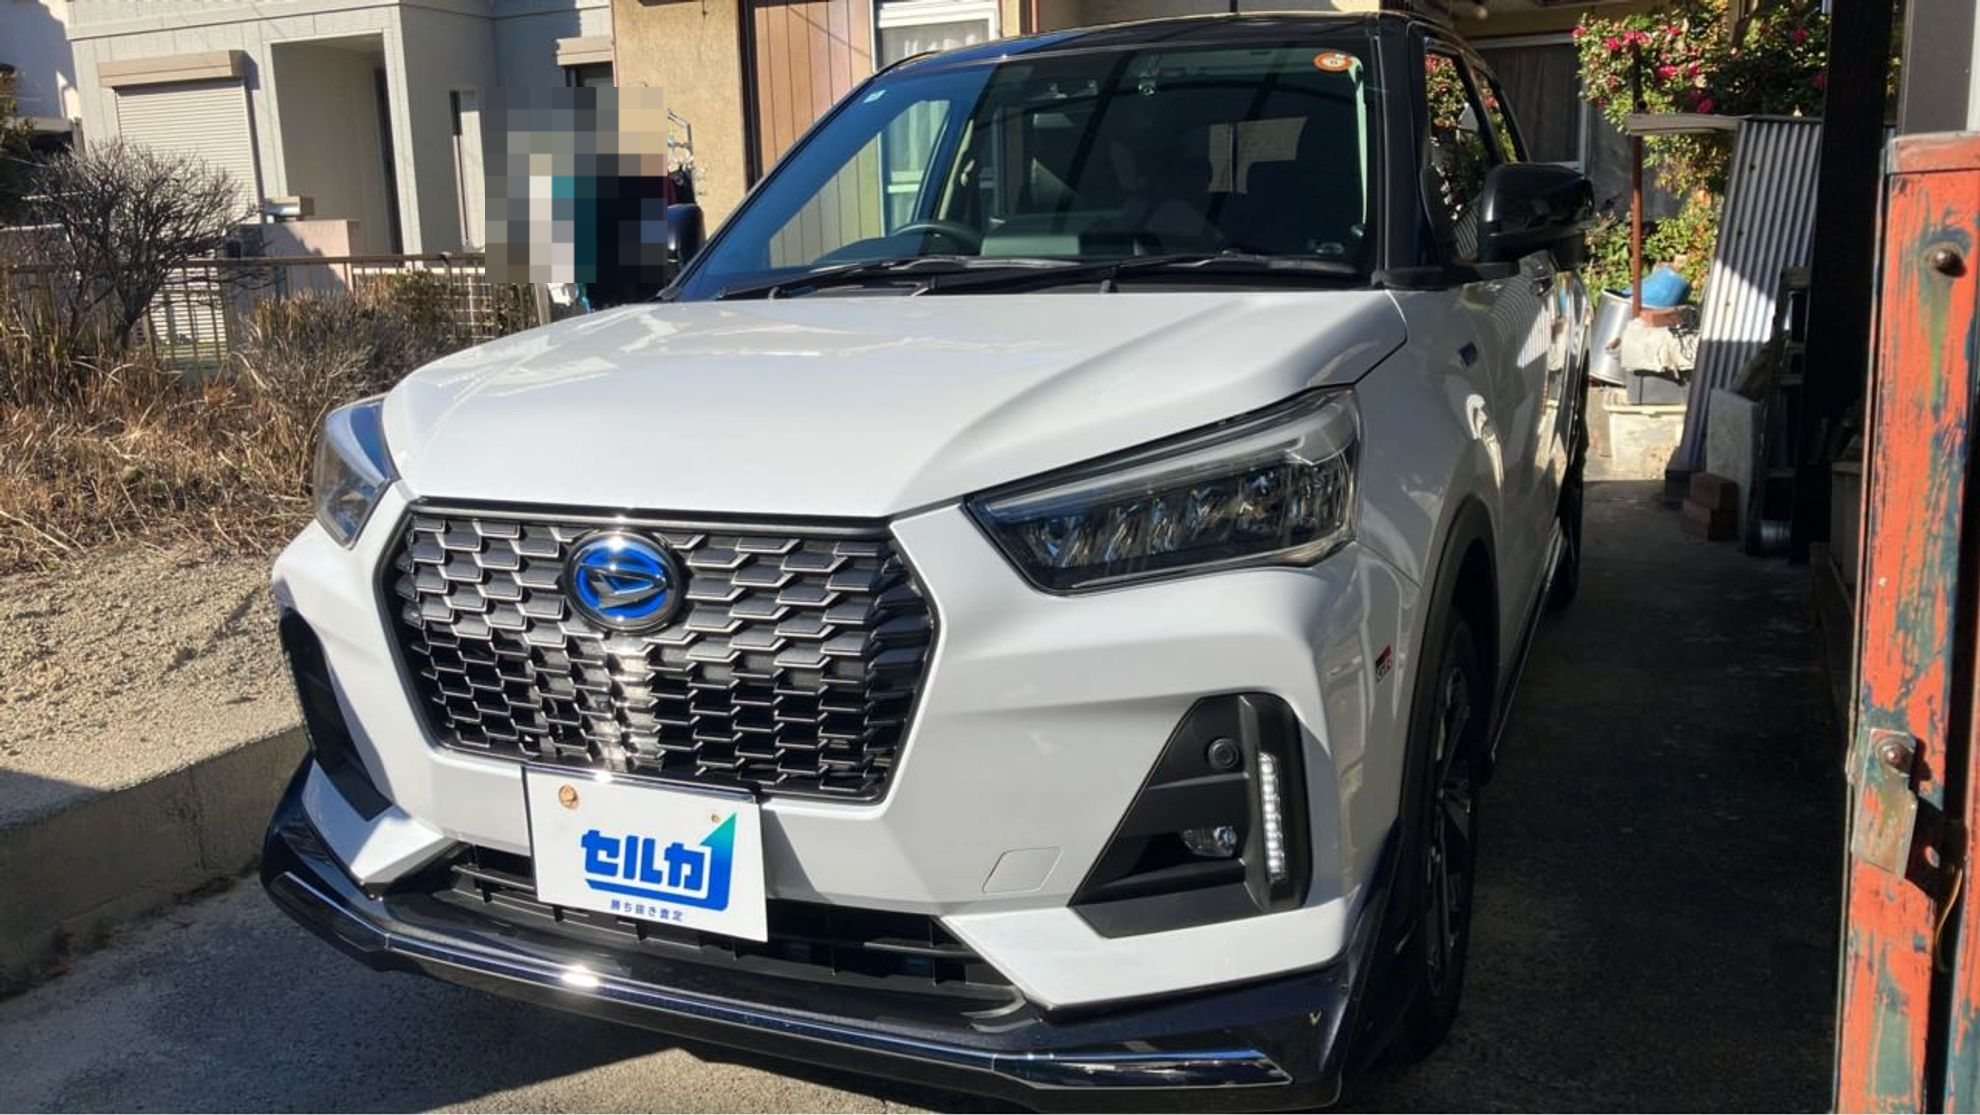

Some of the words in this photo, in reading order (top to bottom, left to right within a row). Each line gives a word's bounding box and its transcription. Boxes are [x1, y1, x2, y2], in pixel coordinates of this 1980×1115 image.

[581, 829, 705, 892] セルカ
[610, 899, 683, 921] 勝ち抜き査定
